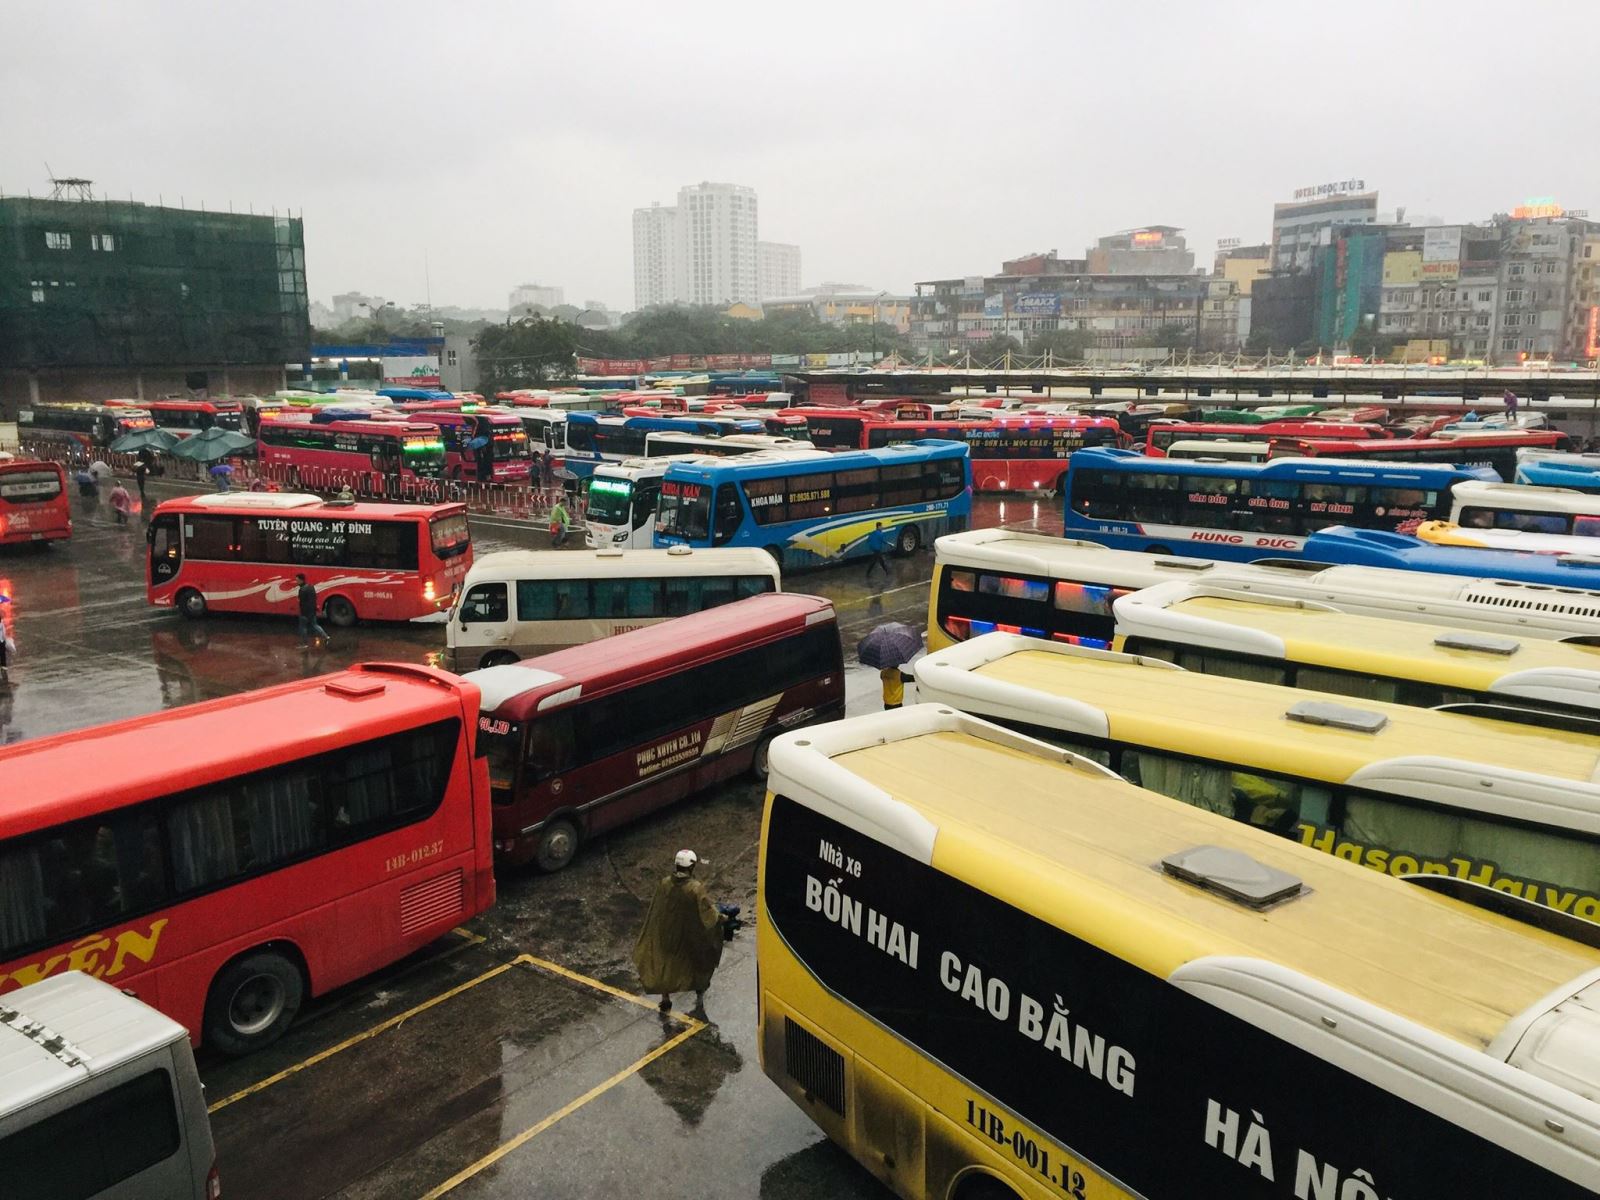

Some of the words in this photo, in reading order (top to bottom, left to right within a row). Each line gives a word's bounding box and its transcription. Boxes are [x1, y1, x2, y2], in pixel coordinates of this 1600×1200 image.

[258, 518, 288, 531] TUYÊN
[291, 521, 324, 533] QUANG
[331, 521, 345, 534] MỸ
[348, 522, 372, 535] ĐÌNH
[751, 494, 768, 507] KHOA
[820, 839, 842, 870] Nhà
[845, 855, 862, 878] xe
[805, 875, 862, 937] BỐN
[867, 908, 919, 969] HAI
[940, 951, 1010, 1021] CAO
[1018, 994, 1136, 1098] BẰNG
[967, 1099, 1086, 1200] 11B-001.12
[1205, 1098, 1275, 1182] HÀ
